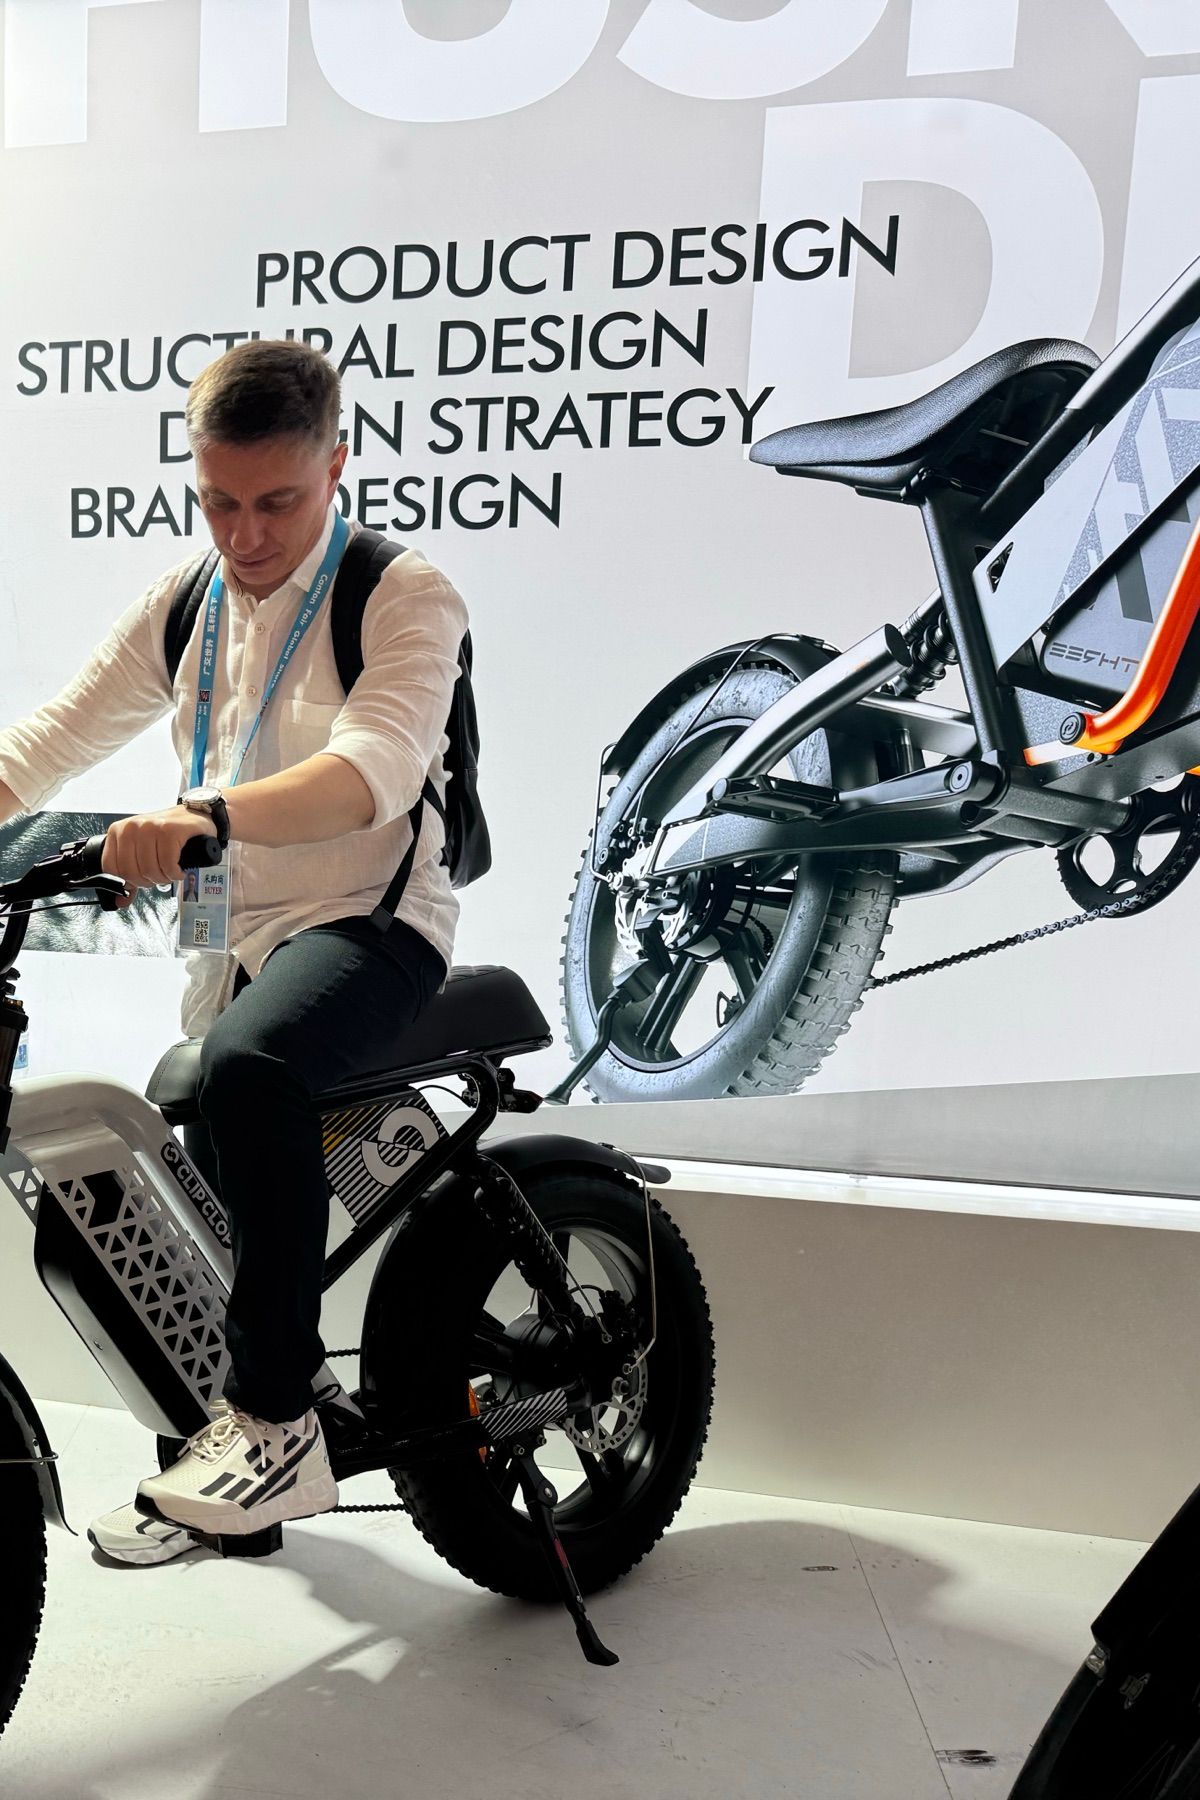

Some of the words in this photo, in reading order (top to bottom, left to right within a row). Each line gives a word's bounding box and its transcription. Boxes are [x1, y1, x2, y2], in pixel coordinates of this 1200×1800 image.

[257, 235, 592, 305] PRODUCT
[613, 215, 899, 290] DESIGN
[16, 324, 414, 396] STRUCTAL
[438, 309, 707, 376] DESIGN
[428, 387, 776, 455] STRATEGY
[71, 484, 202, 538] BRA
[310, 574, 328, 605] Canton
[300, 608, 312, 627] Fair
[203, 638, 214, 676] 广交世界
[284, 630, 300, 660] Global
[204, 874, 224, 885] 采购商
[204, 886, 223, 895] BUYER
[176, 1164, 206, 1201] CLIP
